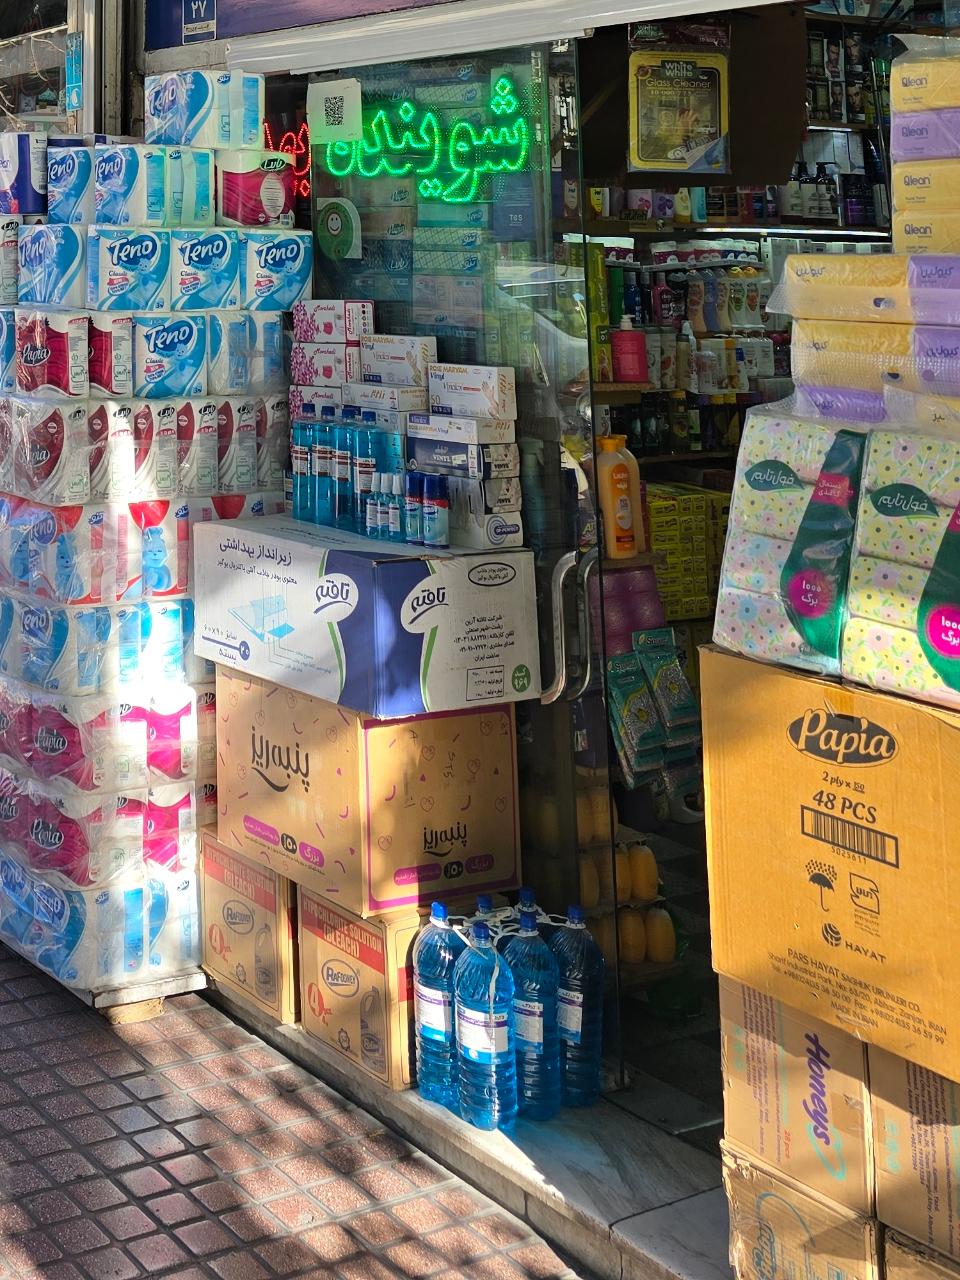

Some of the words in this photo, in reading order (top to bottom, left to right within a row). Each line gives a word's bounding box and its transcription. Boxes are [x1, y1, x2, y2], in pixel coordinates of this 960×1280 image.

[191, 0, 208, 20] ۲۷
[665, 61, 693, 70] White
[665, 69, 693, 77] White
[645, 77, 671, 87] Glass
[673, 78, 712, 88] Cleaner
[109, 236, 154, 266] Teno
[180, 235, 225, 265] Teno
[256, 238, 299, 268] Teno
[145, 324, 190, 353] Teno
[22, 344, 50, 364] Papia
[362, 363, 372, 373] 50
[430, 372, 445, 381] Vinyl
[431, 394, 440, 405] 50
[219, 538, 256, 559] بهداشتی
[257, 544, 292, 568] زیرانداز
[315, 579, 351, 603] تافته
[410, 585, 448, 613] تافته
[797, 707, 896, 765] Papia
[822, 771, 829, 782] 2
[829, 774, 844, 788] ply
[812, 789, 837, 811] 48
[840, 796, 878, 824] PCS
[302, 847, 321, 865] بزرگ
[323, 923, 360, 958] (BLEACH)
[348, 921, 382, 953] SOLUTION
[787, 947, 809, 966] PARS
[810, 958, 839, 978] HAYAT
[845, 940, 887, 965] HAYAT
[802, 1032, 832, 1147] Homeys
